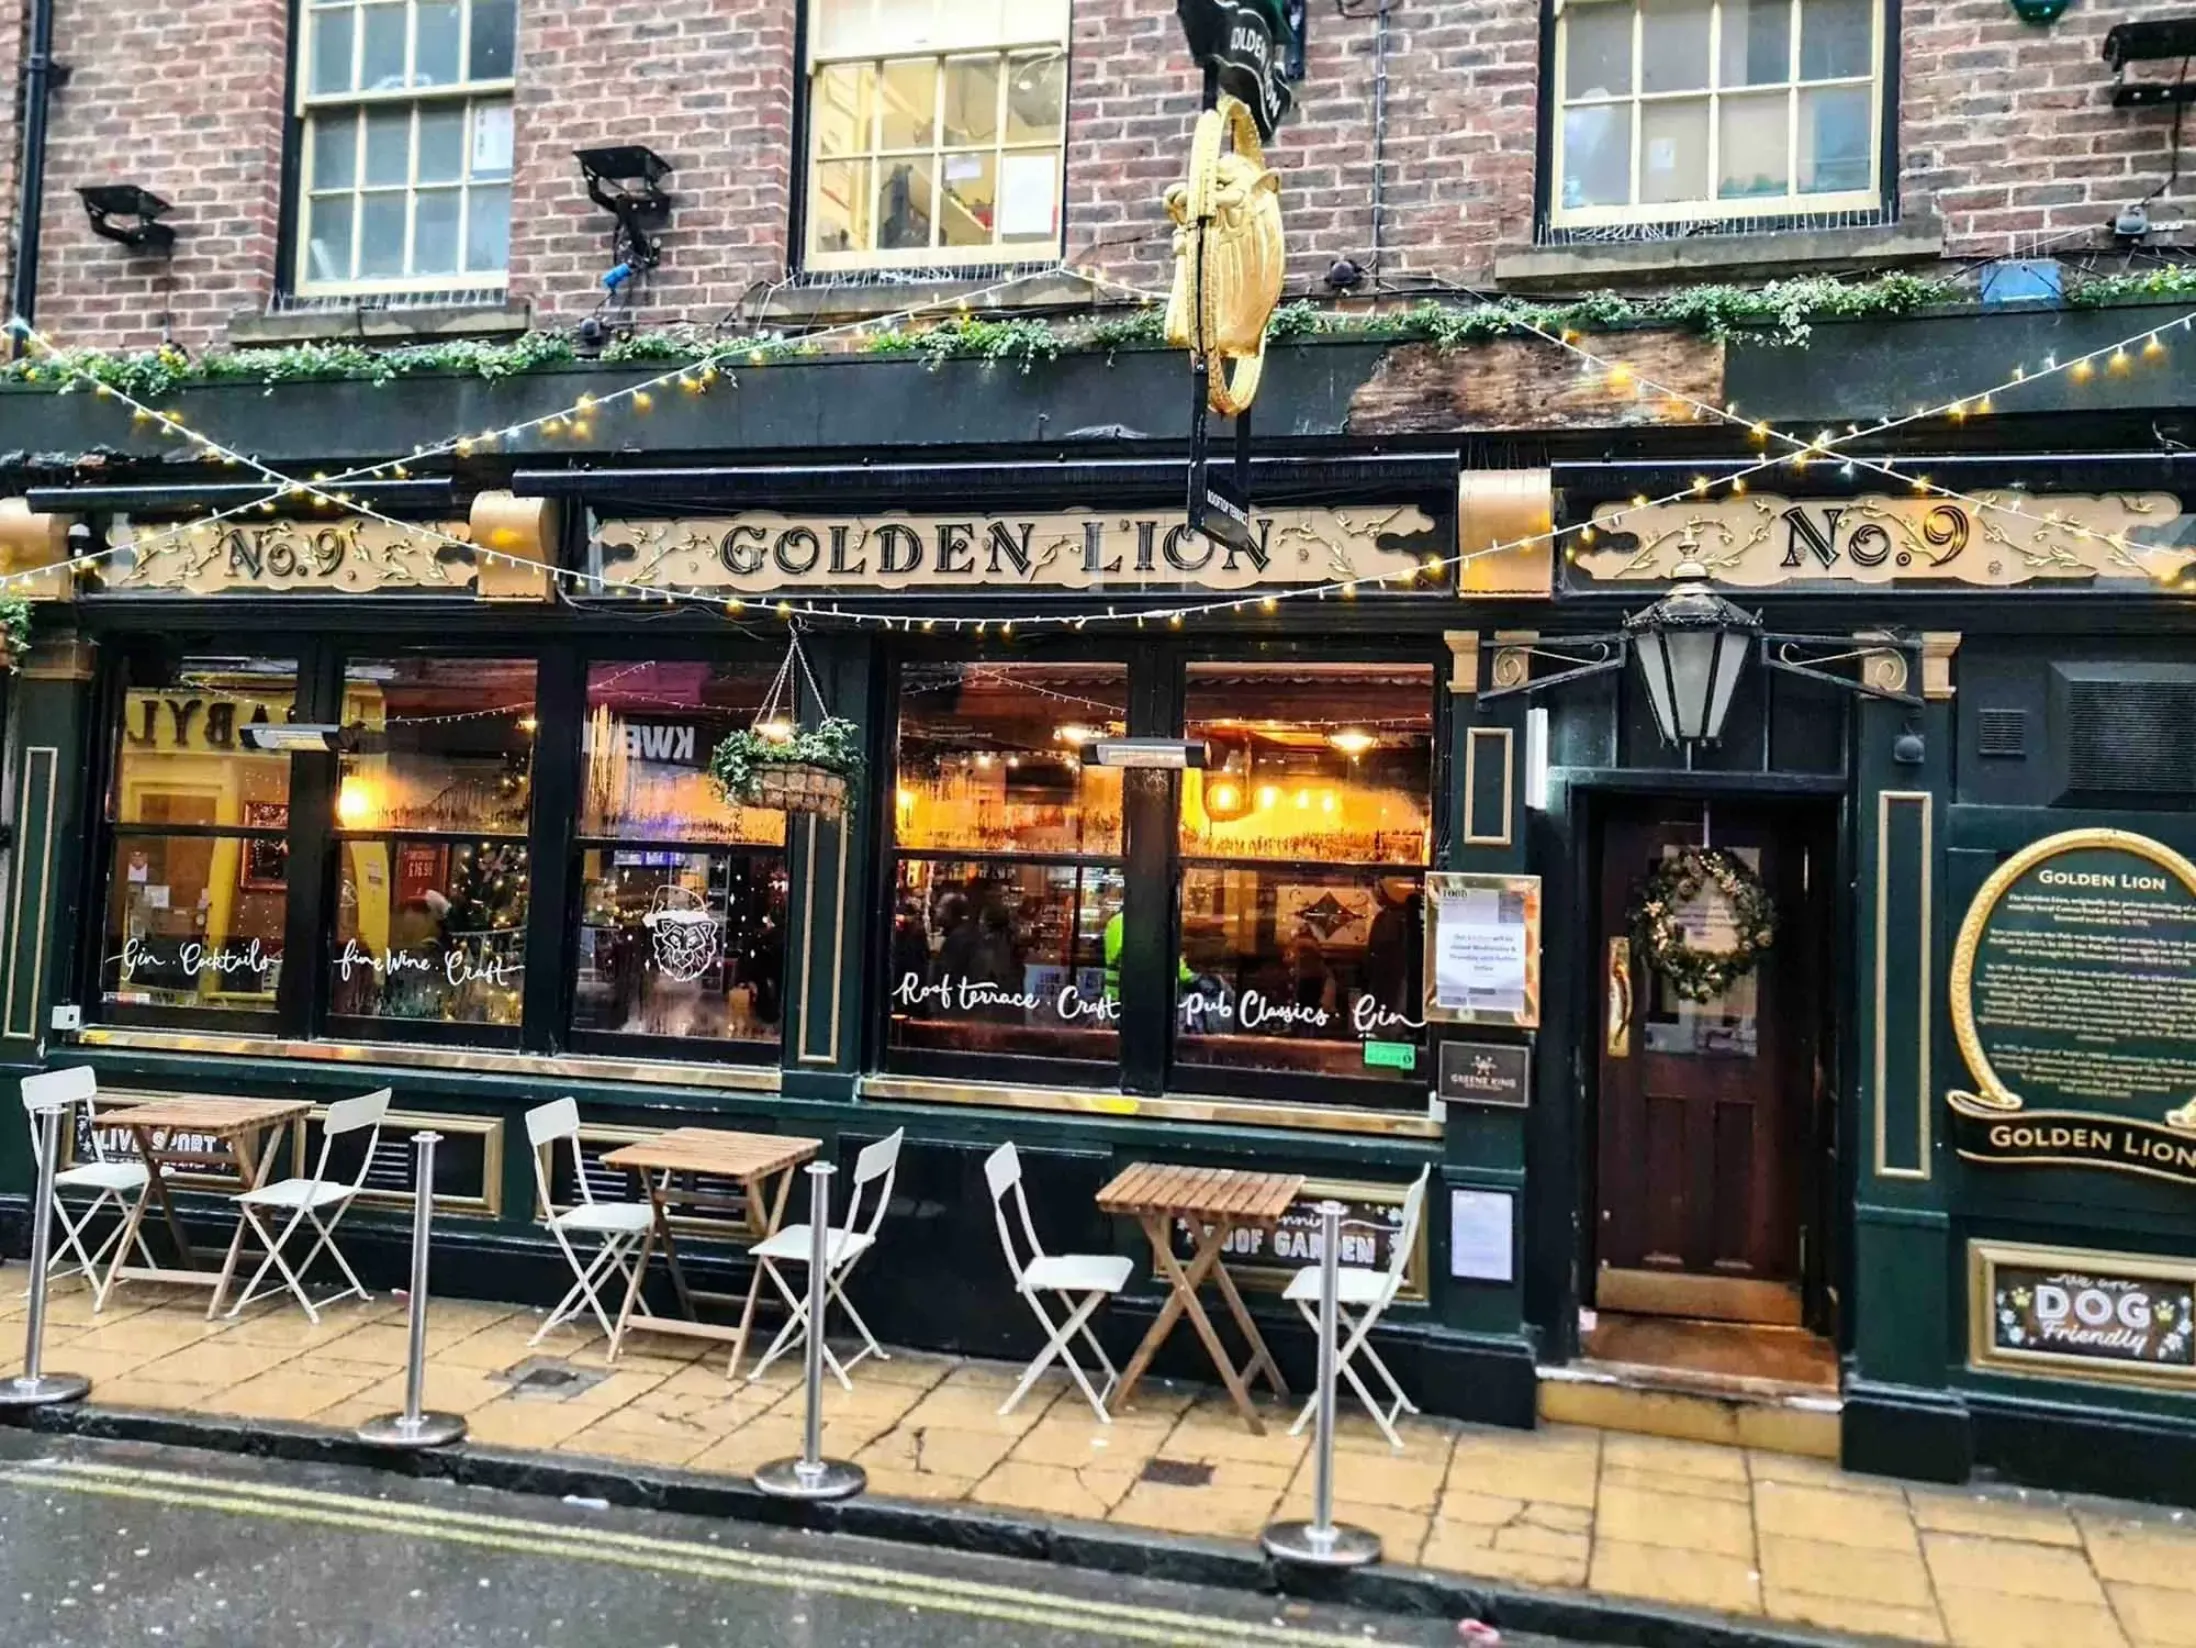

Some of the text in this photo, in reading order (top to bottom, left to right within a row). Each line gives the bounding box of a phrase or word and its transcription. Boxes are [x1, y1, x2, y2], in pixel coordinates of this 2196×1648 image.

[718, 519, 1274, 576] GOLDEN LION
[2038, 869, 2167, 891] GOLDEN LION
[105, 937, 284, 981] Gin Cocktails
[444, 950, 526, 986] Craft
[891, 971, 952, 1009] Roof
[1057, 985, 1122, 1020] Craft
[1239, 989, 1330, 1028] Classics
[1352, 993, 1427, 1039] Gin
[1989, 1124, 2196, 1169] GOLDEN LION
[2034, 1284, 2150, 1329] DOG
[2042, 1319, 2149, 1356] Friendly
